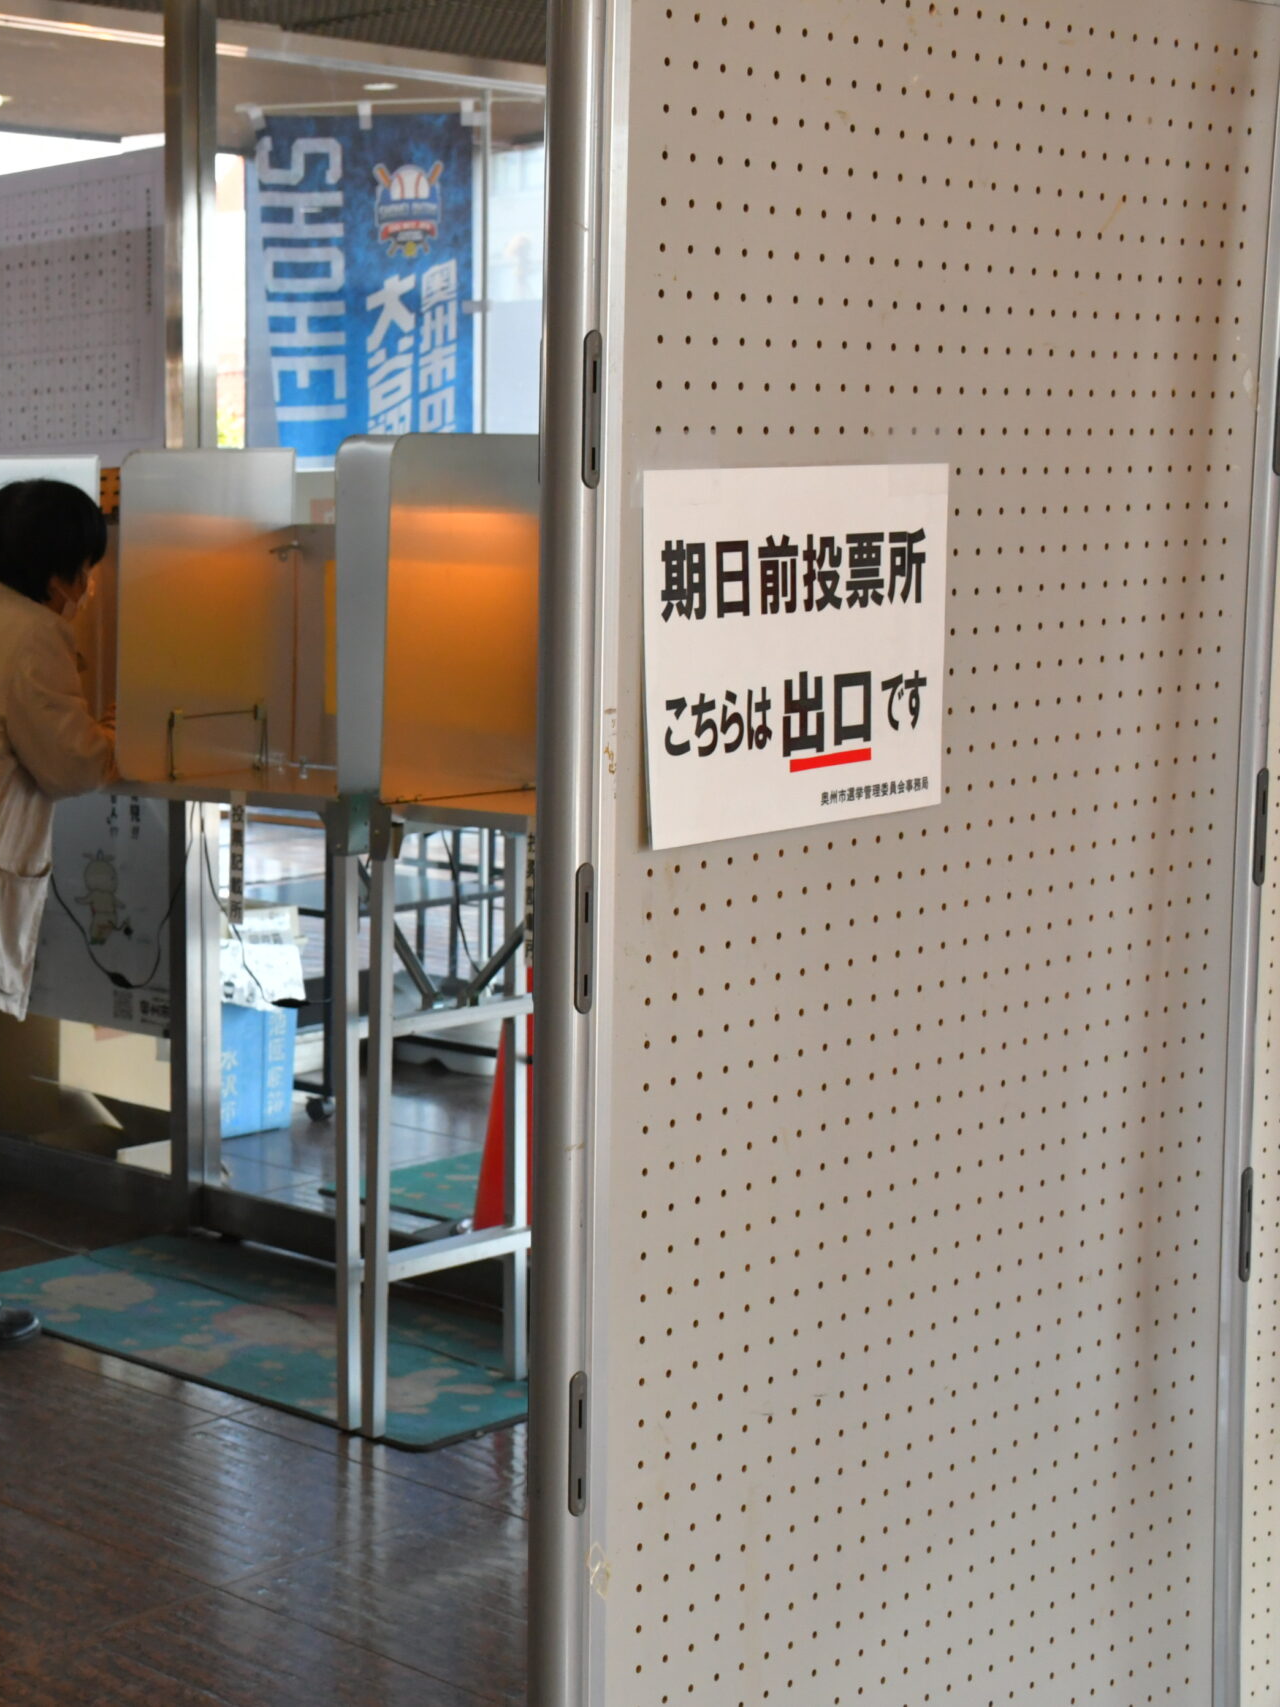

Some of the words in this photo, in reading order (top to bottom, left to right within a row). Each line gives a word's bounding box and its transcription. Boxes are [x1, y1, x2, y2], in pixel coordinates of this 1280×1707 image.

[256, 136, 347, 422] SHOHEI
[419, 258, 457, 434] 奥州市の
[661, 528, 927, 623] 期日前投票所
[820, 776, 929, 806] 奥州市選挙管理委員会事務局
